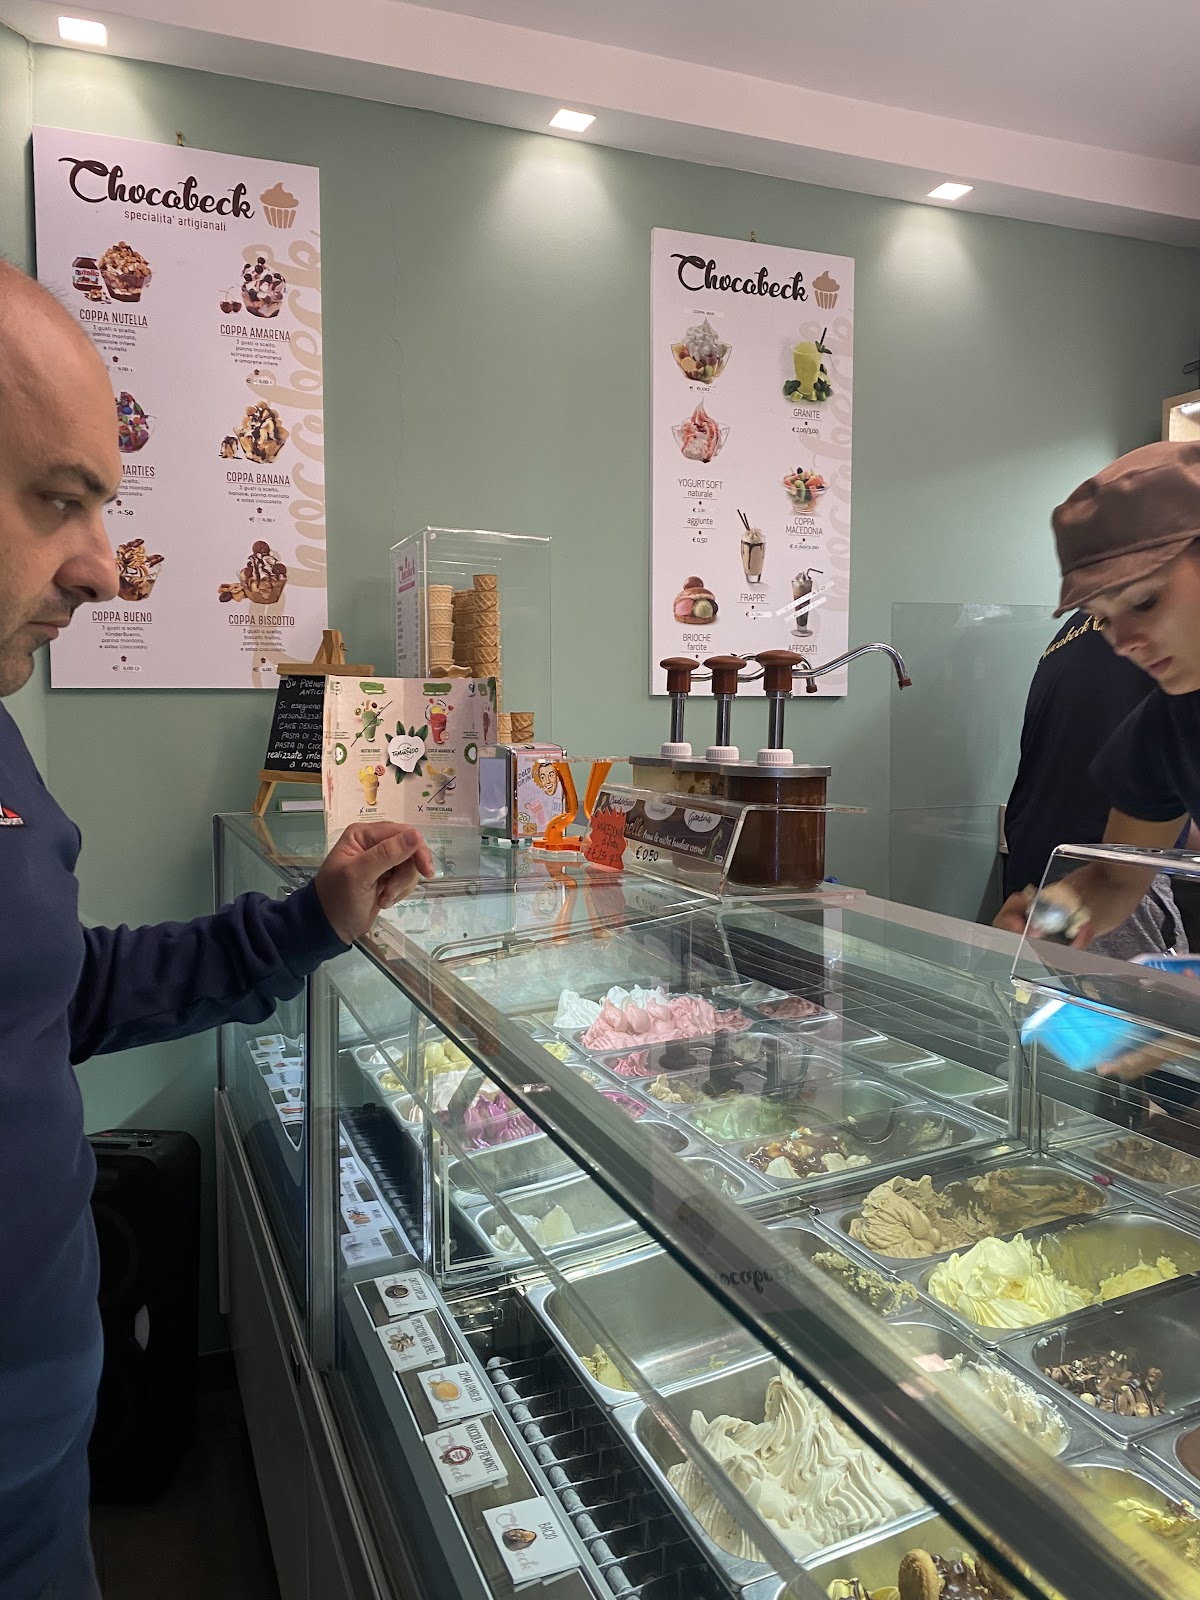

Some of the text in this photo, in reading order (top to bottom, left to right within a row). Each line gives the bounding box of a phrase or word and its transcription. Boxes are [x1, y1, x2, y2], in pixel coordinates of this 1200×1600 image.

[178, 216, 226, 232] artigianali
[80, 309, 148, 326] COPPA NUTELLA
[220, 324, 290, 341] COPPA AMARENA
[793, 409, 820, 419] GRANITE
[227, 471, 290, 485] COPPA BANANA
[678, 478, 723, 489] YOGURT SOFT
[688, 490, 713, 498] naturale
[687, 517, 713, 526] aggiunte
[794, 517, 815, 526] COPPA
[786, 526, 823, 535] MACEDONIA
[92, 610, 152, 622] COPPA BUENO
[228, 615, 294, 626] COPPA BISCOTTO
[281, 732, 299, 740] PASTA
[275, 741, 295, 749] PASTA
[267, 751, 302, 760] realizzate
[636, 846, 642, 859] €
[537, 1521, 558, 1541] BACIO
